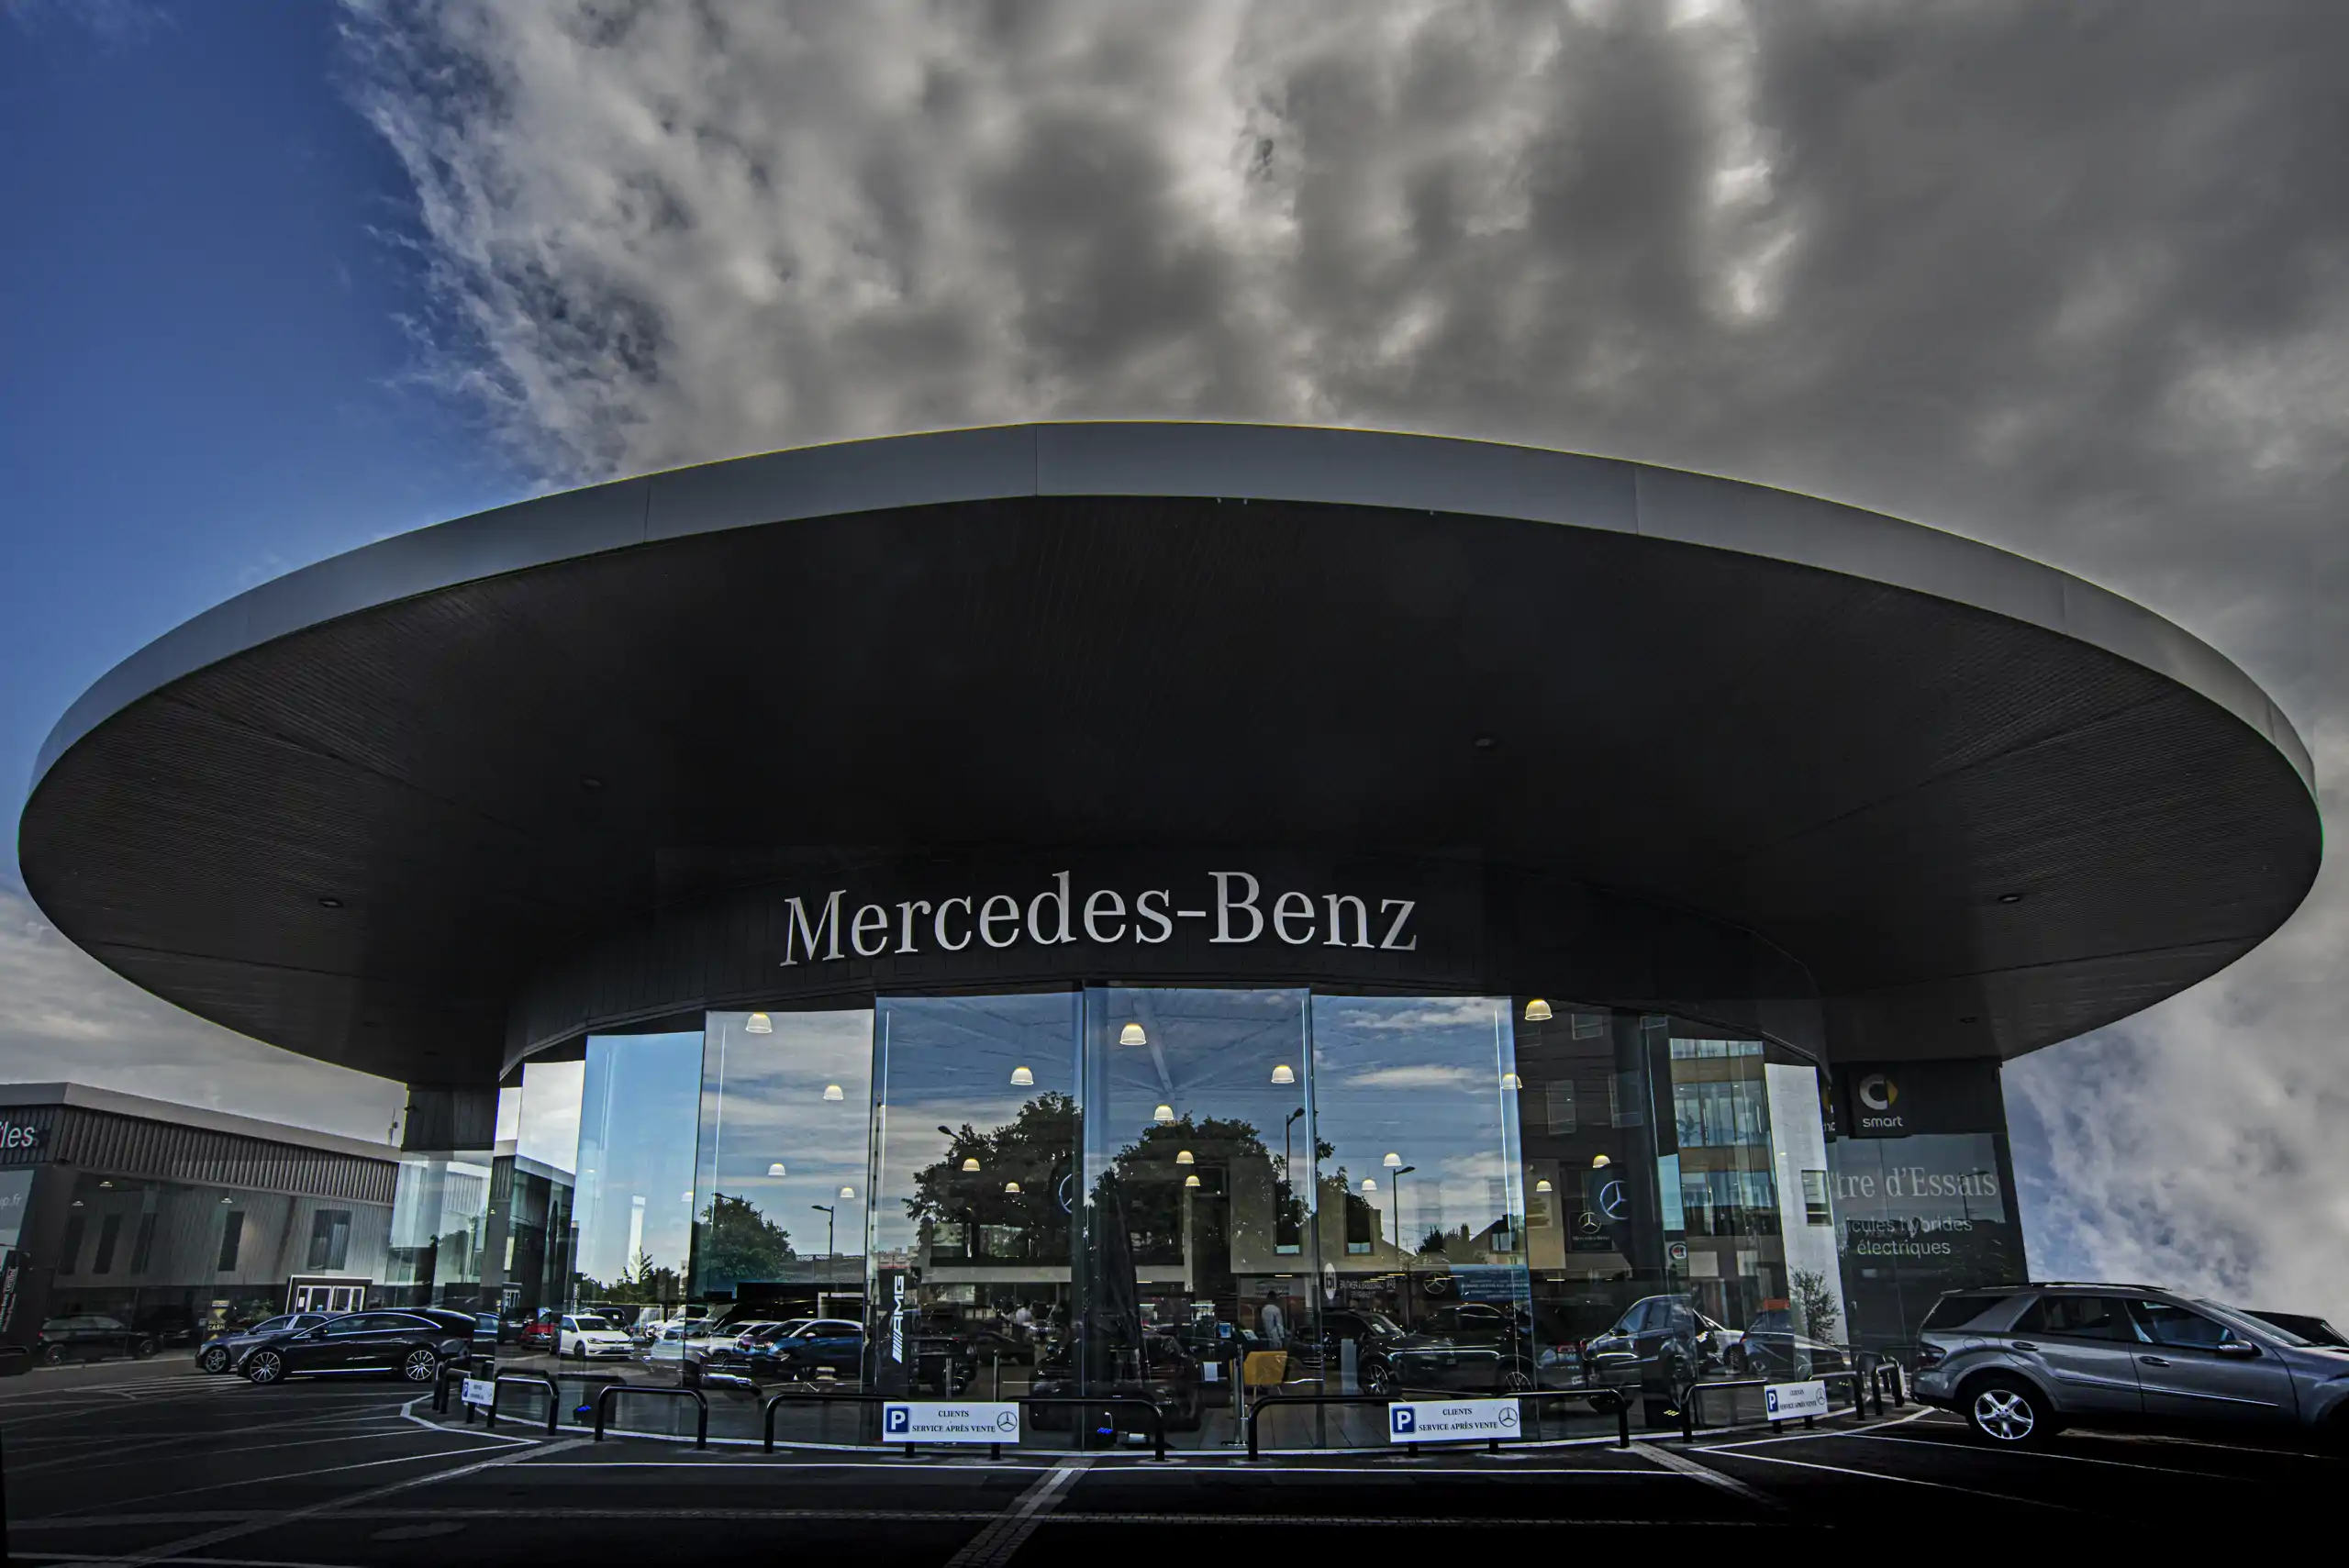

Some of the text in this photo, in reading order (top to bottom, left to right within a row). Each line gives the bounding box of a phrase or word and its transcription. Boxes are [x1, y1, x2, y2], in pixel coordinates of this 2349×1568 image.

[780, 870, 1418, 966] Mercedes-Benz
[1863, 1116, 1903, 1128] smart
[1886, 1166, 1998, 1196] d'Essais
[0, 1194, 22, 1209] p.fr
[1899, 1216, 1973, 1239] hybrides
[1857, 1239, 1951, 1259] électriques
[893, 1275, 905, 1340] AMG
[1768, 1393, 1776, 1410] P
[891, 1411, 906, 1429] P
[945, 1424, 970, 1432] APRÈS
[1397, 1410, 1412, 1430] P
[1418, 1421, 1498, 1431] SERVICE APRÈS VENTE
